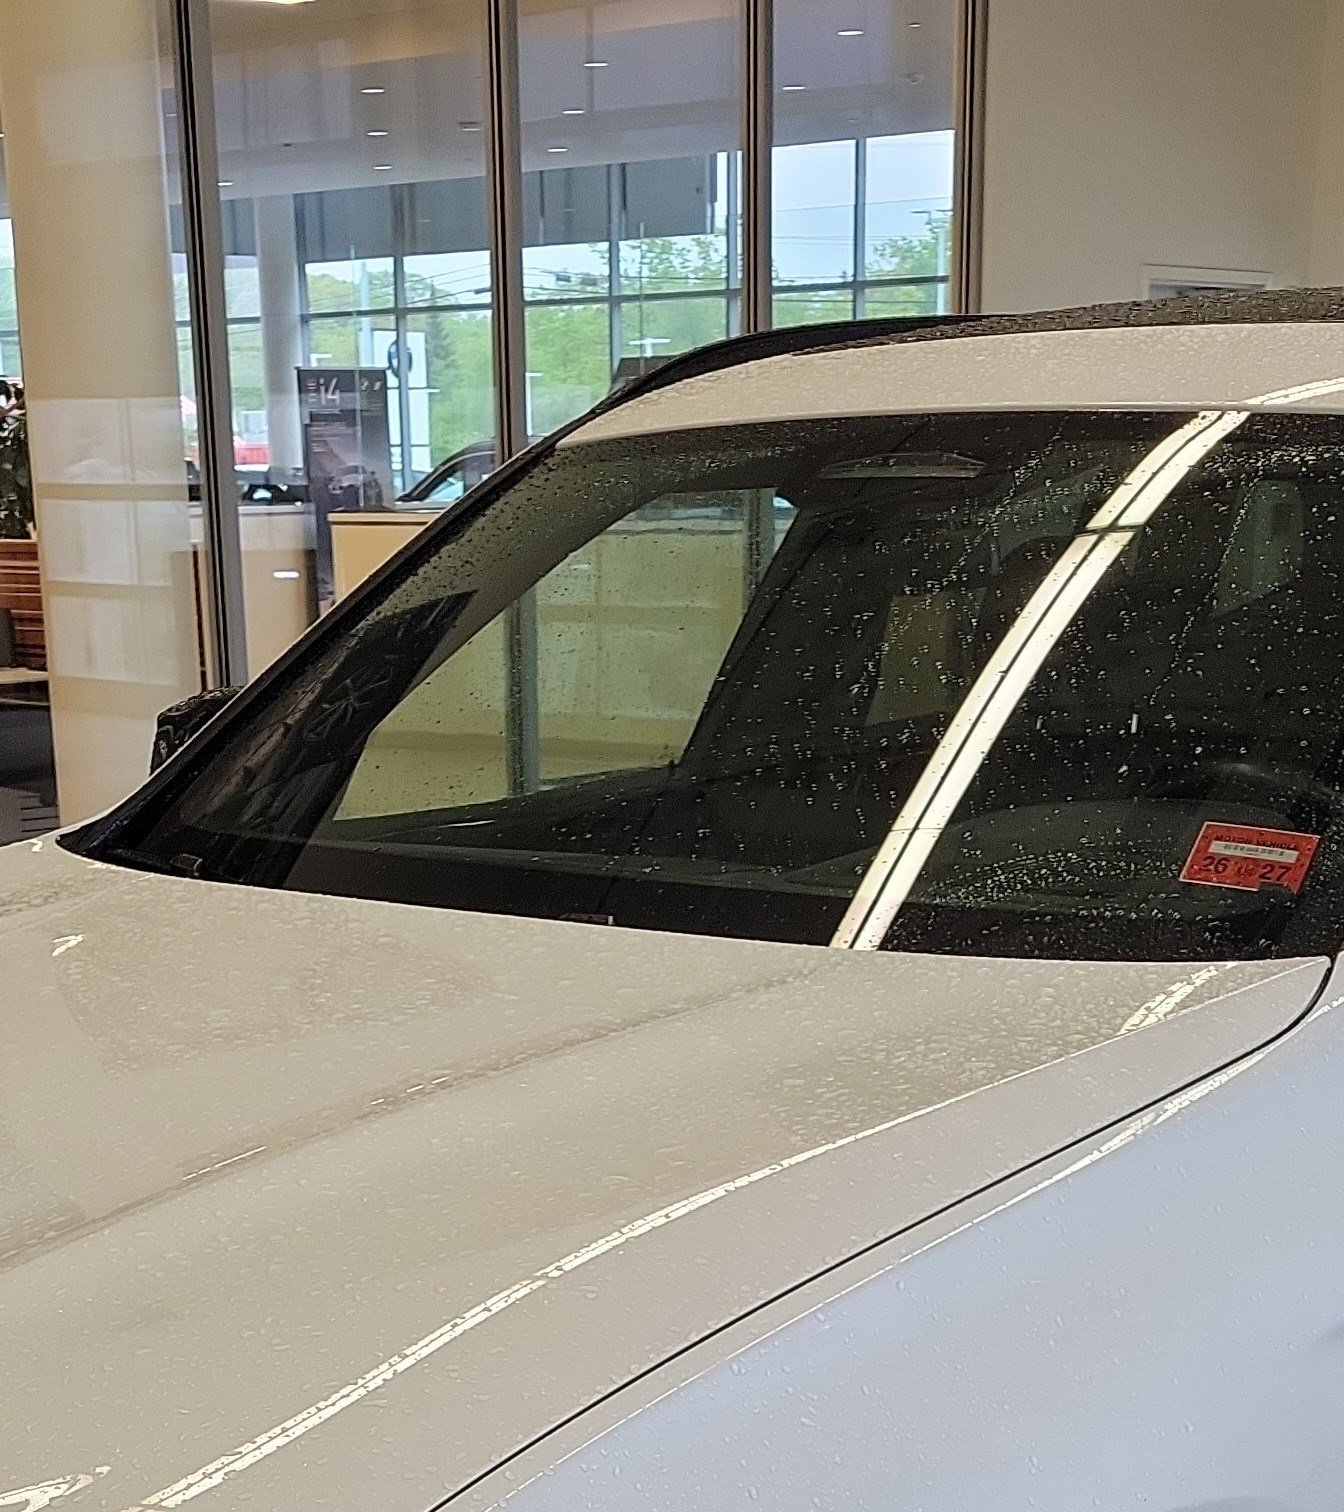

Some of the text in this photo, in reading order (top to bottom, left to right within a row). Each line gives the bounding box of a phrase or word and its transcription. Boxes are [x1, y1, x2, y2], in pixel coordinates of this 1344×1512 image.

[318, 377, 340, 406] i4
[1198, 855, 1230, 874] 26
[1257, 863, 1293, 882] 27
